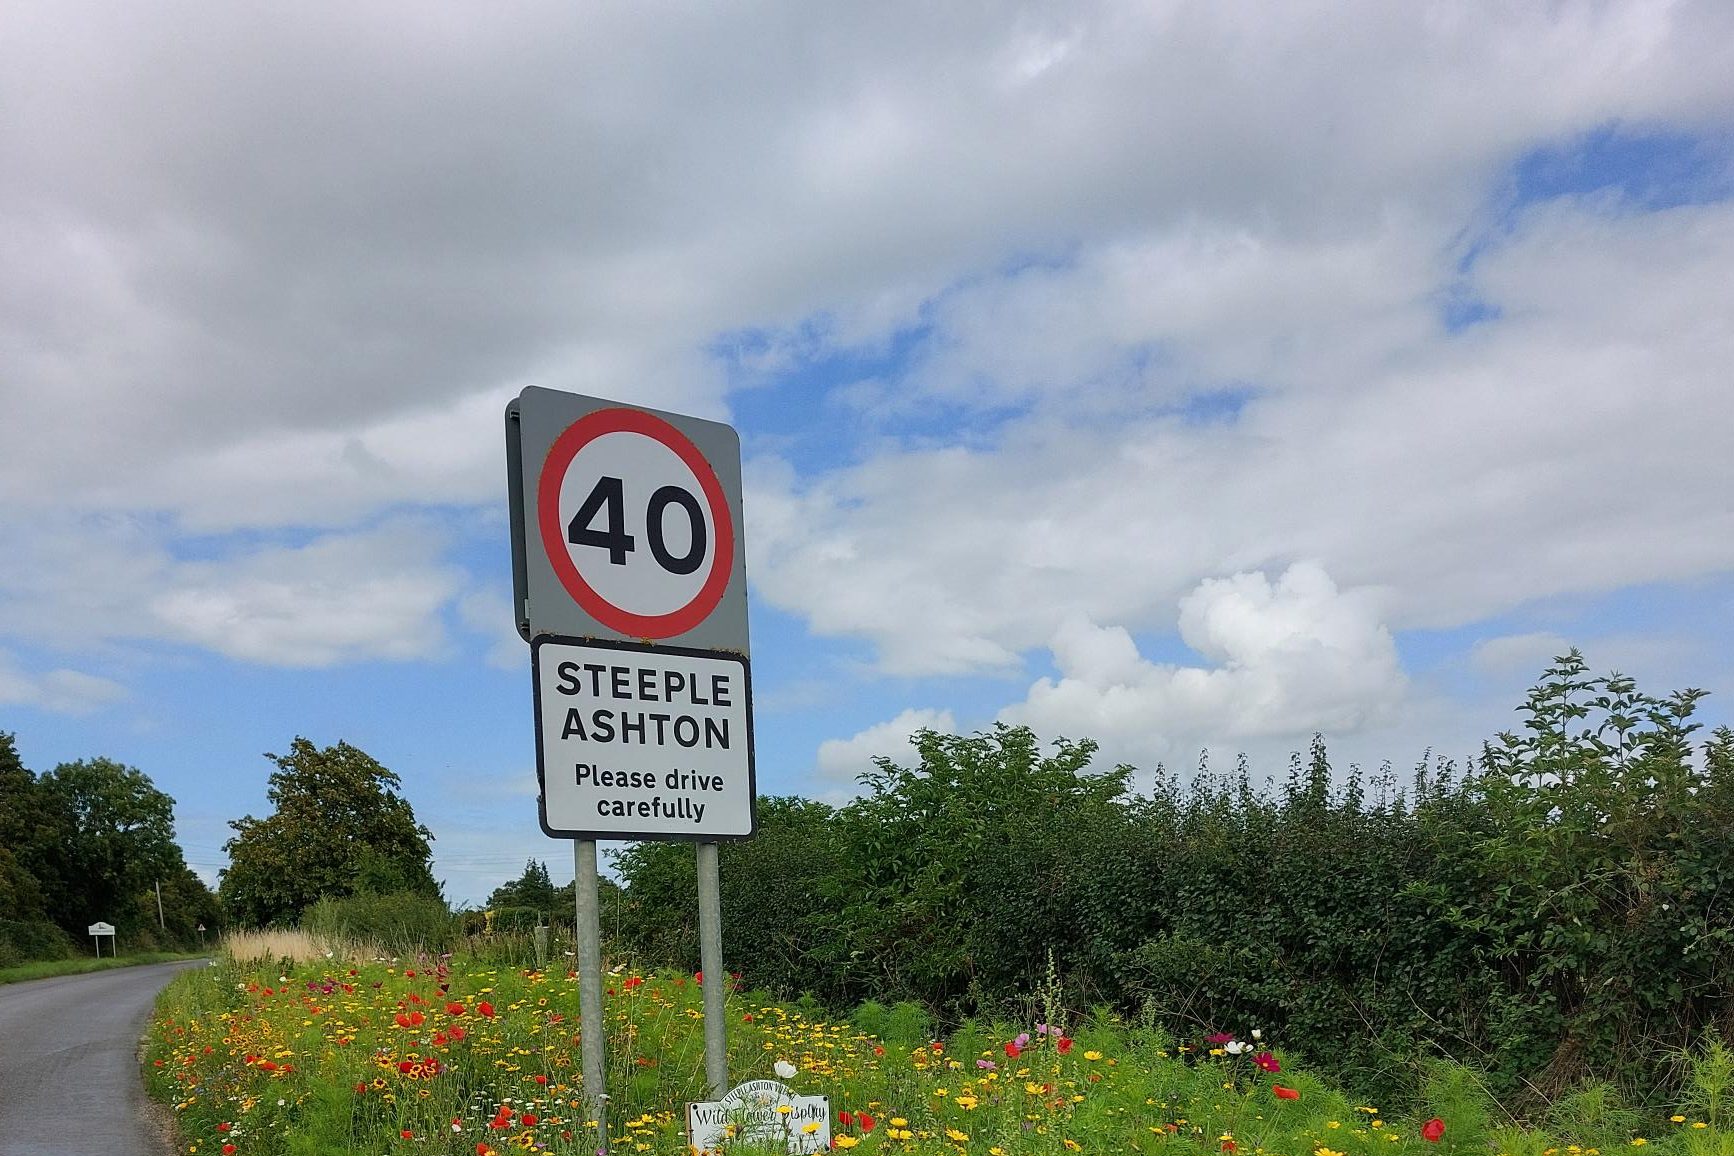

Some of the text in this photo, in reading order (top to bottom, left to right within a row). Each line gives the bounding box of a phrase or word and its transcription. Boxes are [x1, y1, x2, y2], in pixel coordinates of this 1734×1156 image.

[568, 476, 706, 575] 40
[556, 661, 732, 708] STEEPLE
[560, 707, 730, 750] ASHTON
[576, 763, 724, 793] Please drive
[597, 796, 706, 824] carefully
[749, 1081, 774, 1092] ASHTON
[695, 1108, 730, 1125] Wild
[732, 1107, 776, 1124] lower
